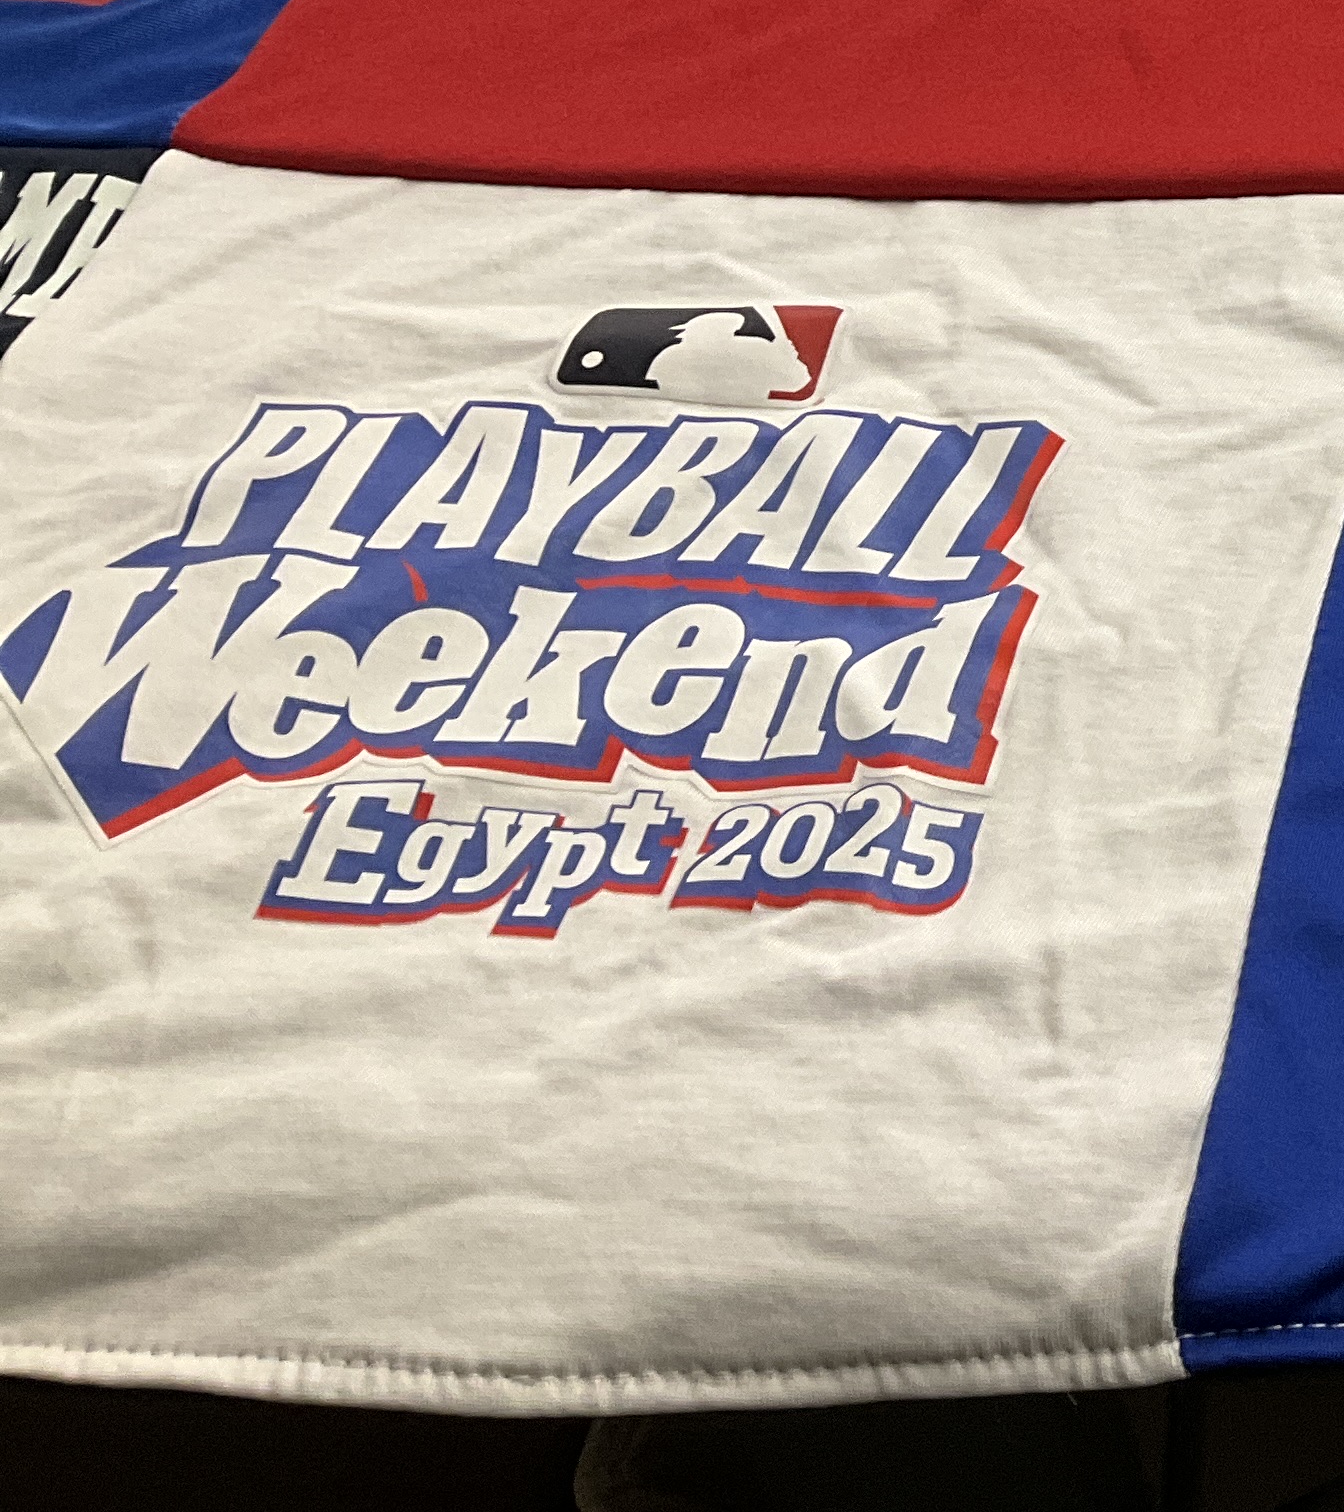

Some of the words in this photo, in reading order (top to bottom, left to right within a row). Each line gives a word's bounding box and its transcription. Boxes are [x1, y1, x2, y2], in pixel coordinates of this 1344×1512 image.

[15, 552, 1026, 772] Weekend
[274, 780, 669, 918] Egypt
[688, 784, 967, 892] 2025
